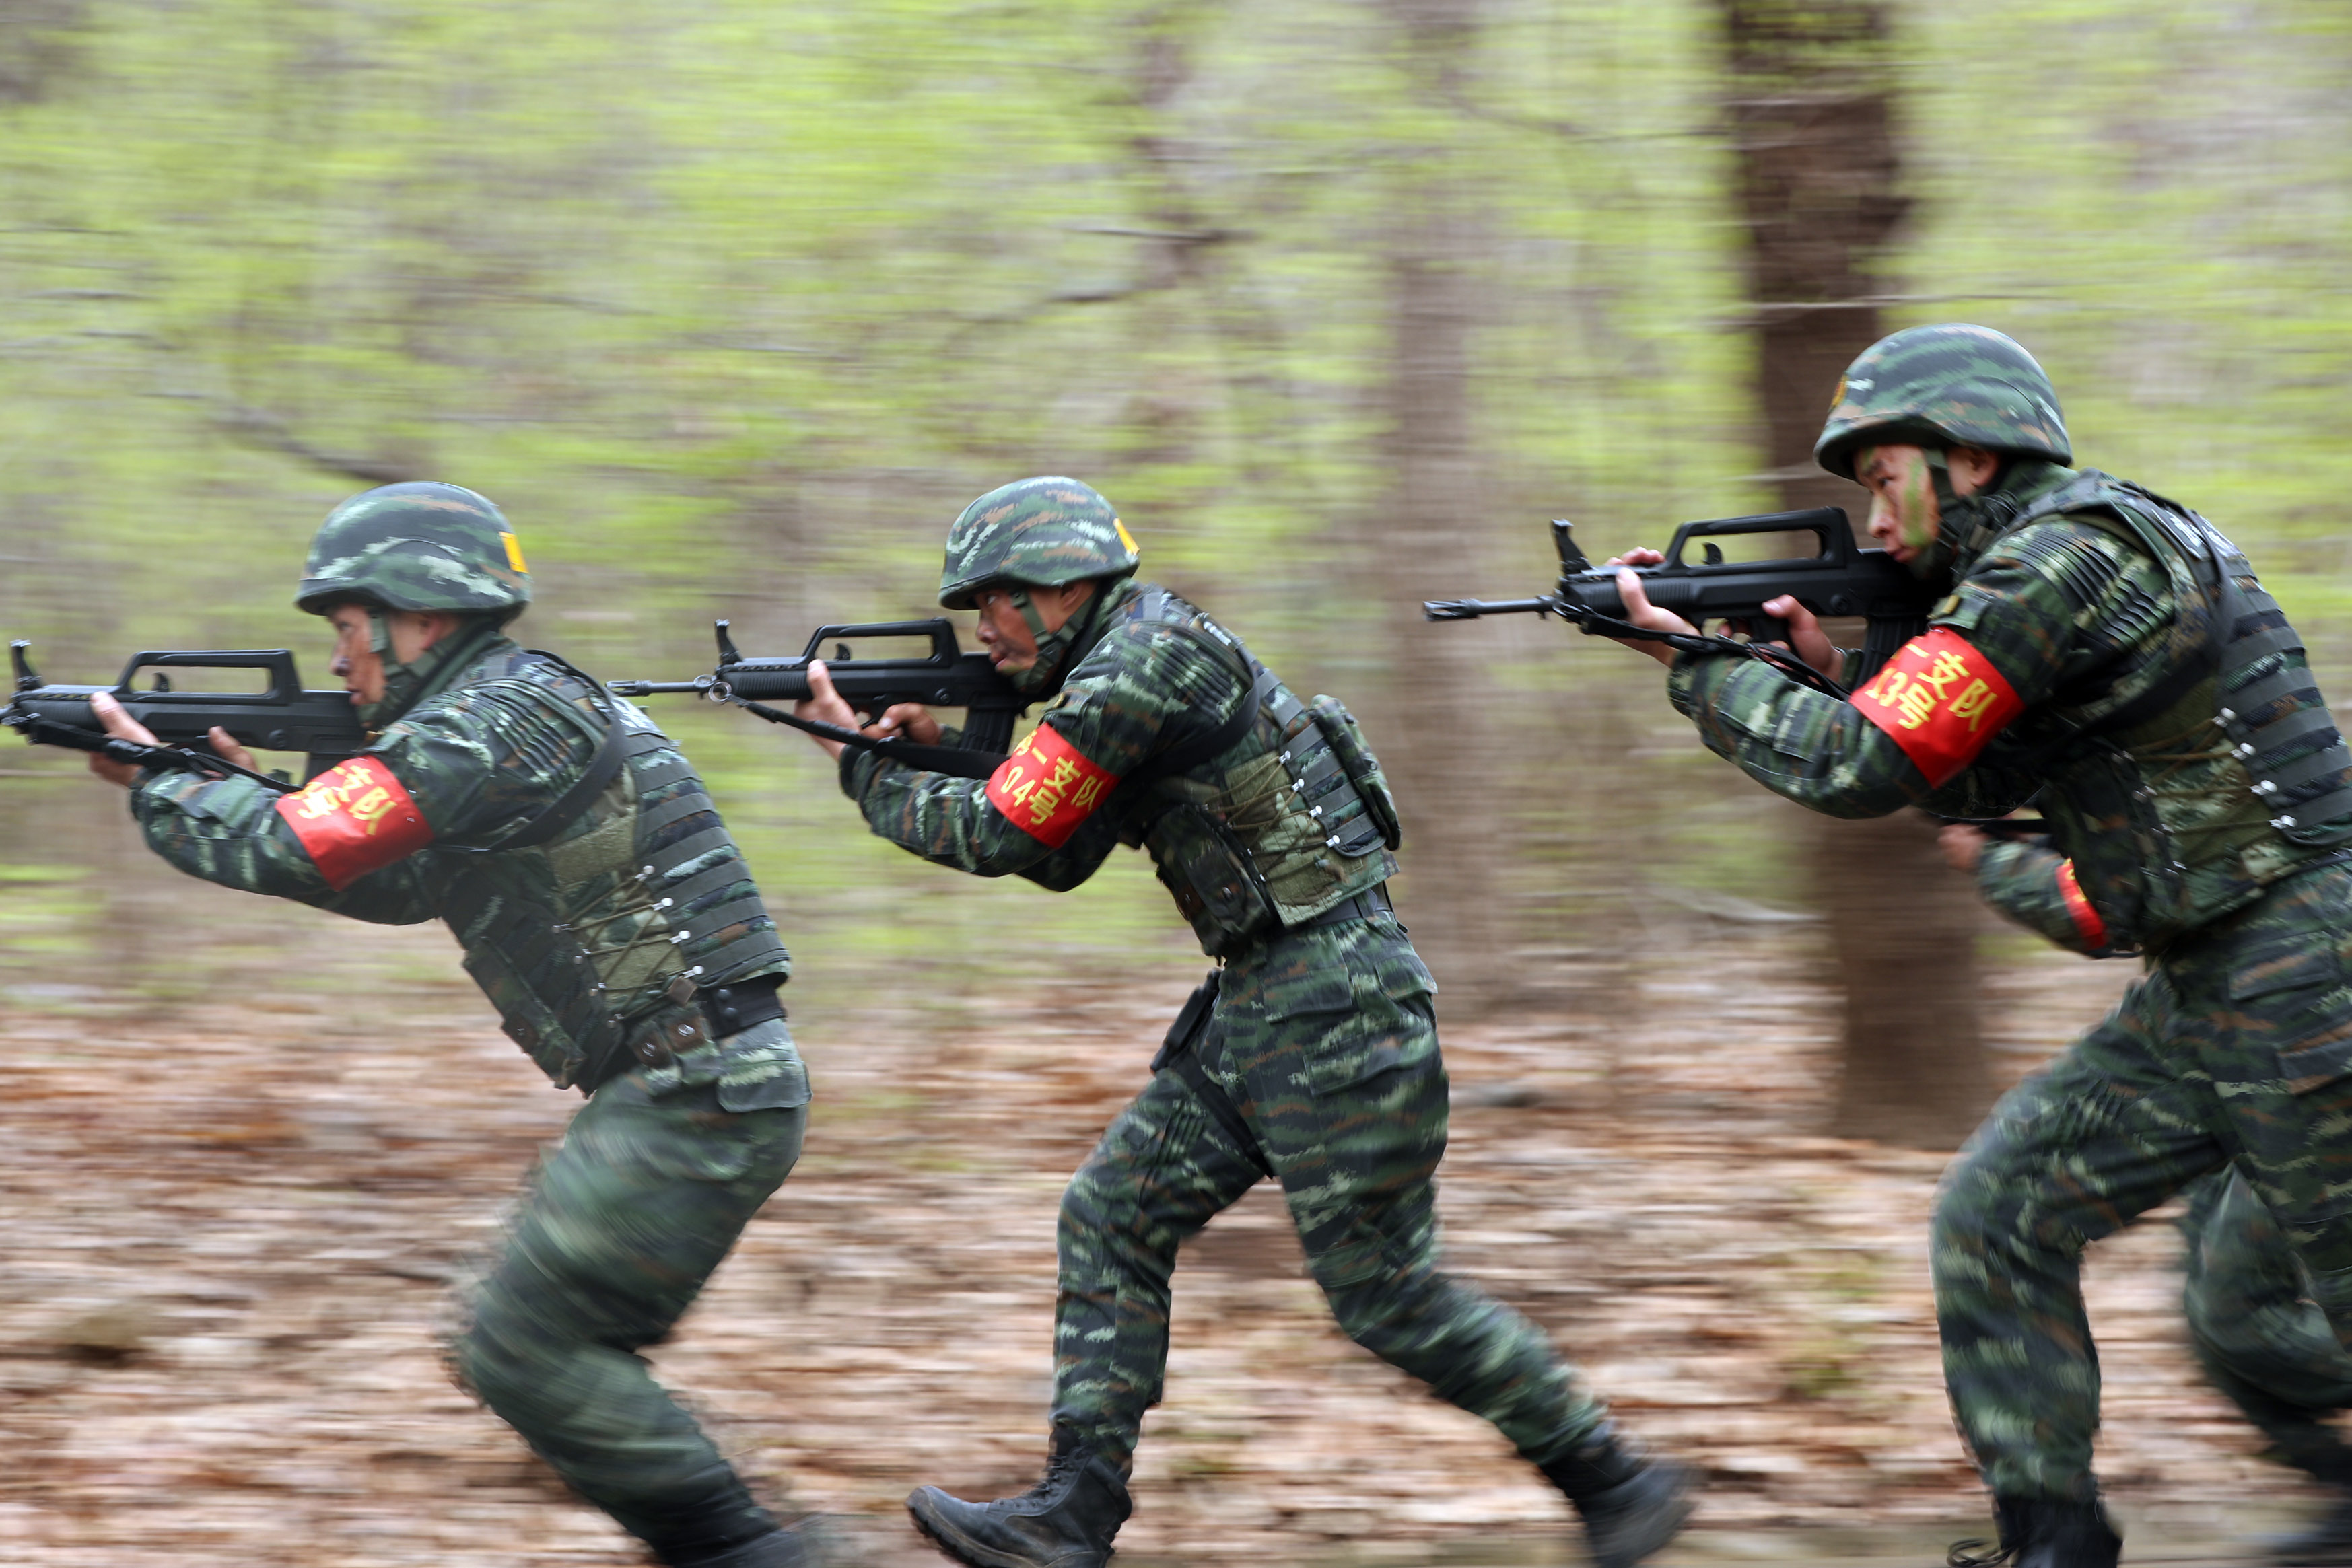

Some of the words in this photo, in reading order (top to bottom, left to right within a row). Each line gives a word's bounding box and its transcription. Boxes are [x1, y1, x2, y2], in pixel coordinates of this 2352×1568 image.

[1864, 667, 1938, 730] 13号
[1890, 635, 1998, 732] 一支队
[1000, 766, 1060, 826] 04号
